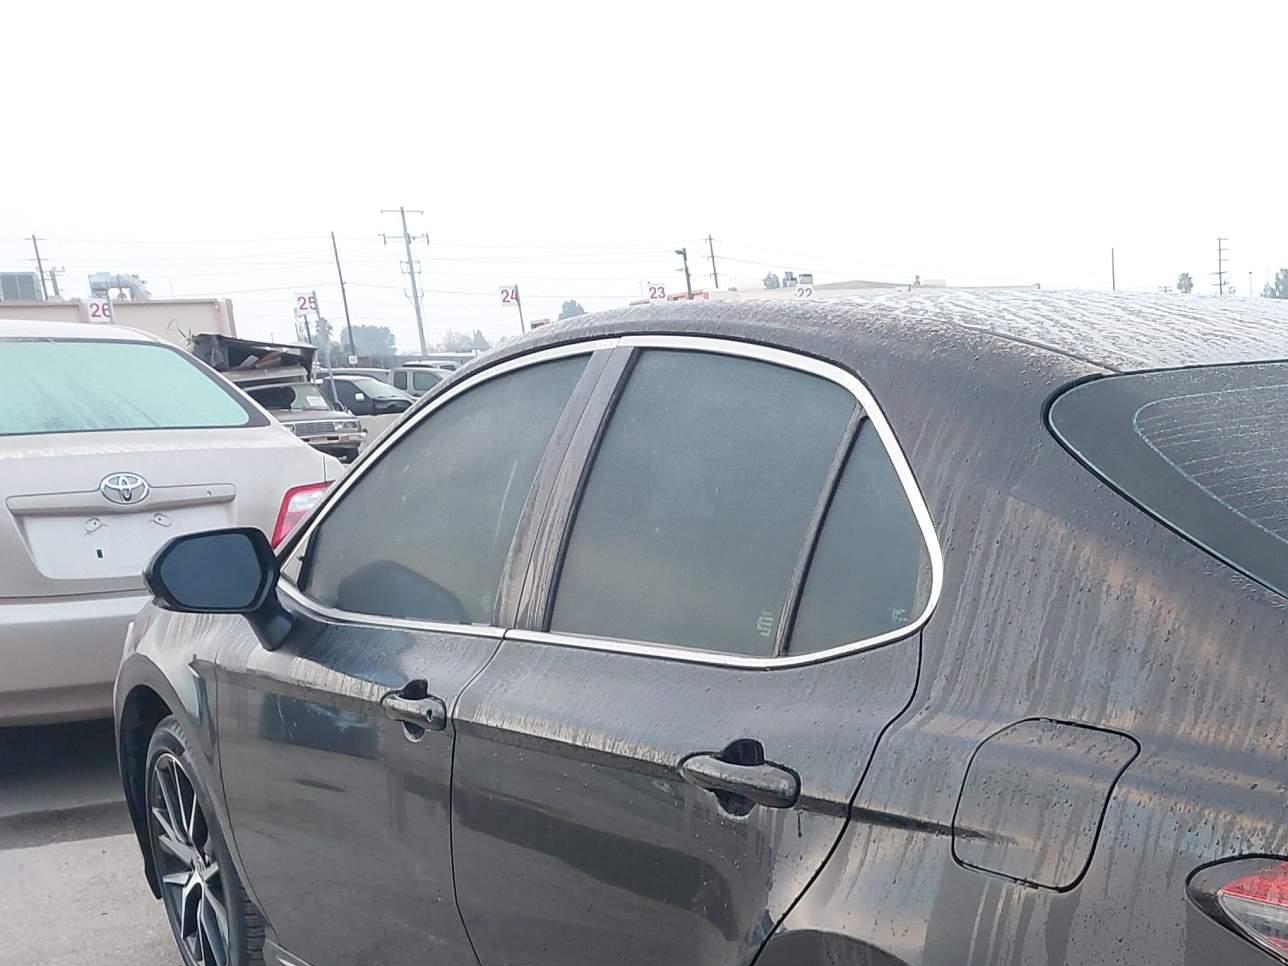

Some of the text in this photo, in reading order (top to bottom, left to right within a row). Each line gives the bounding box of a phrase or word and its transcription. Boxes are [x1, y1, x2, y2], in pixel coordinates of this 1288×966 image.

[500, 288, 518, 303] 24
[649, 286, 666, 299] 23
[90, 302, 110, 318] 26
[297, 296, 317, 310] 25
